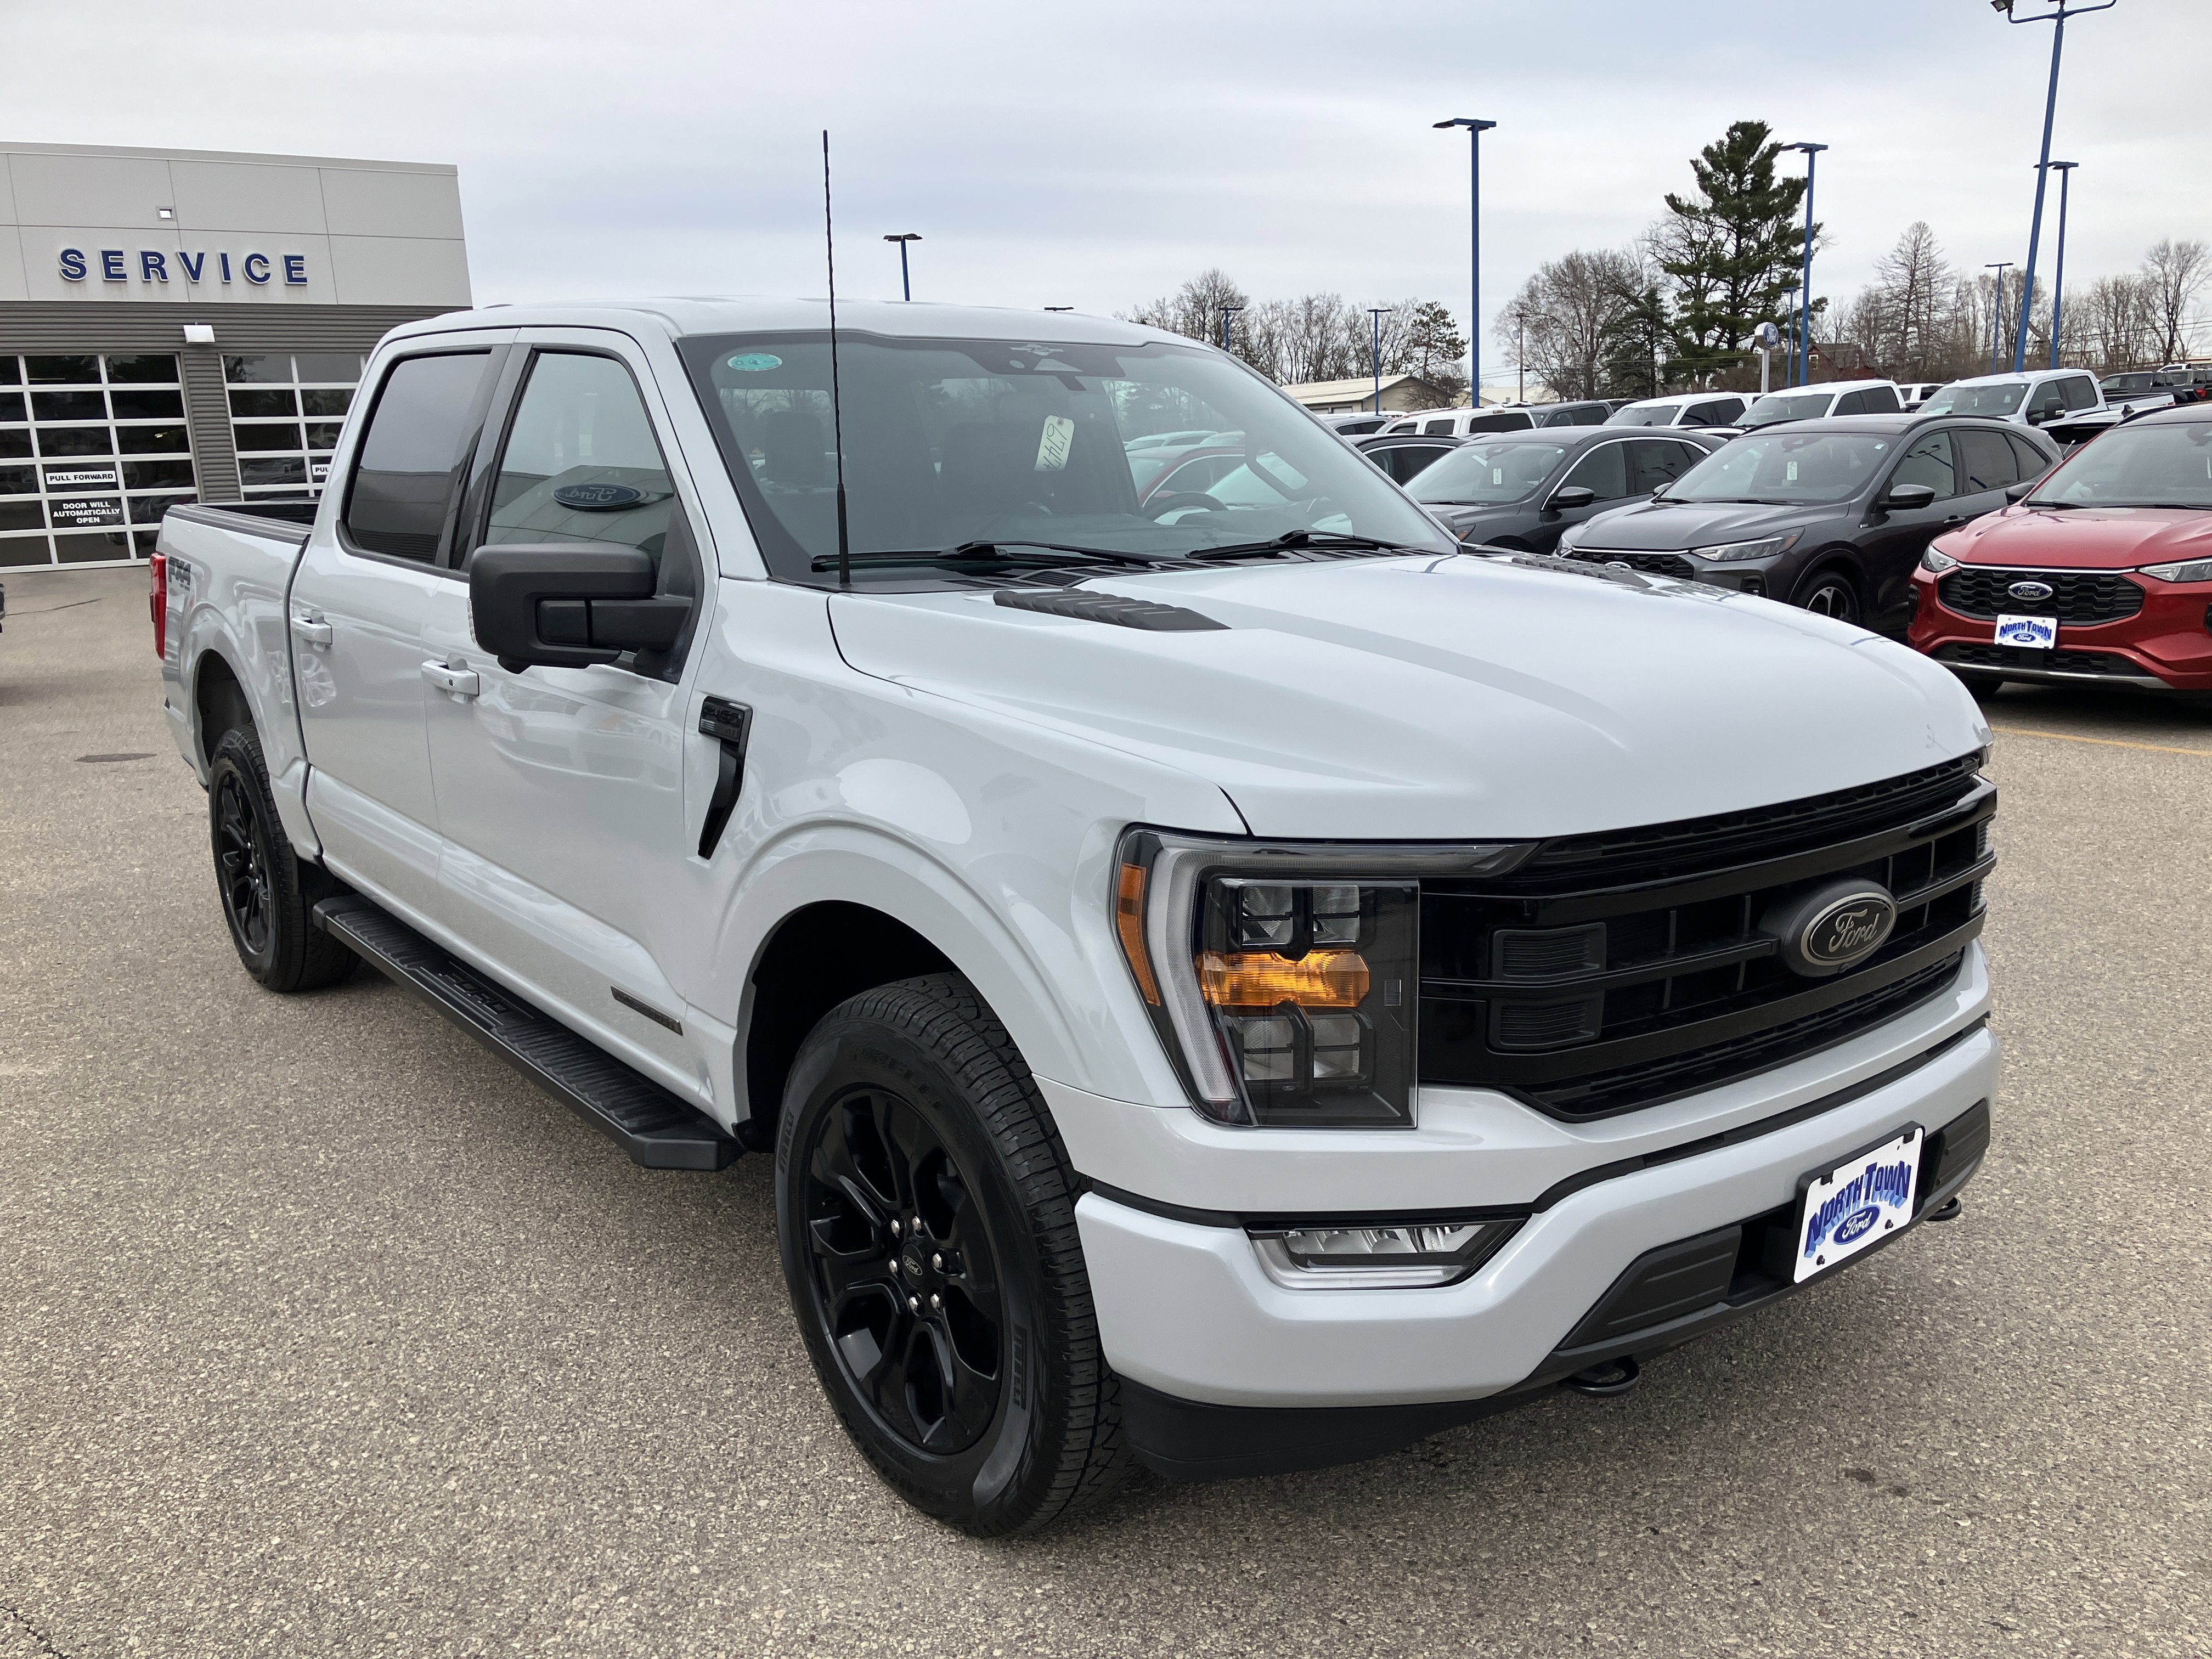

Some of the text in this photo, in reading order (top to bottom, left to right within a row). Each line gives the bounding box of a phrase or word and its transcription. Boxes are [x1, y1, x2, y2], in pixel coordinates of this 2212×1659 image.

[59, 247, 308, 285] SERVICE
[53, 508, 120, 517] AUTOMATICALLY
[2017, 585, 2041, 596] Ford
[1828, 908, 1880, 952] Ford
[1842, 1211, 1873, 1240] Ford
[905, 1257, 919, 1273] Ford
